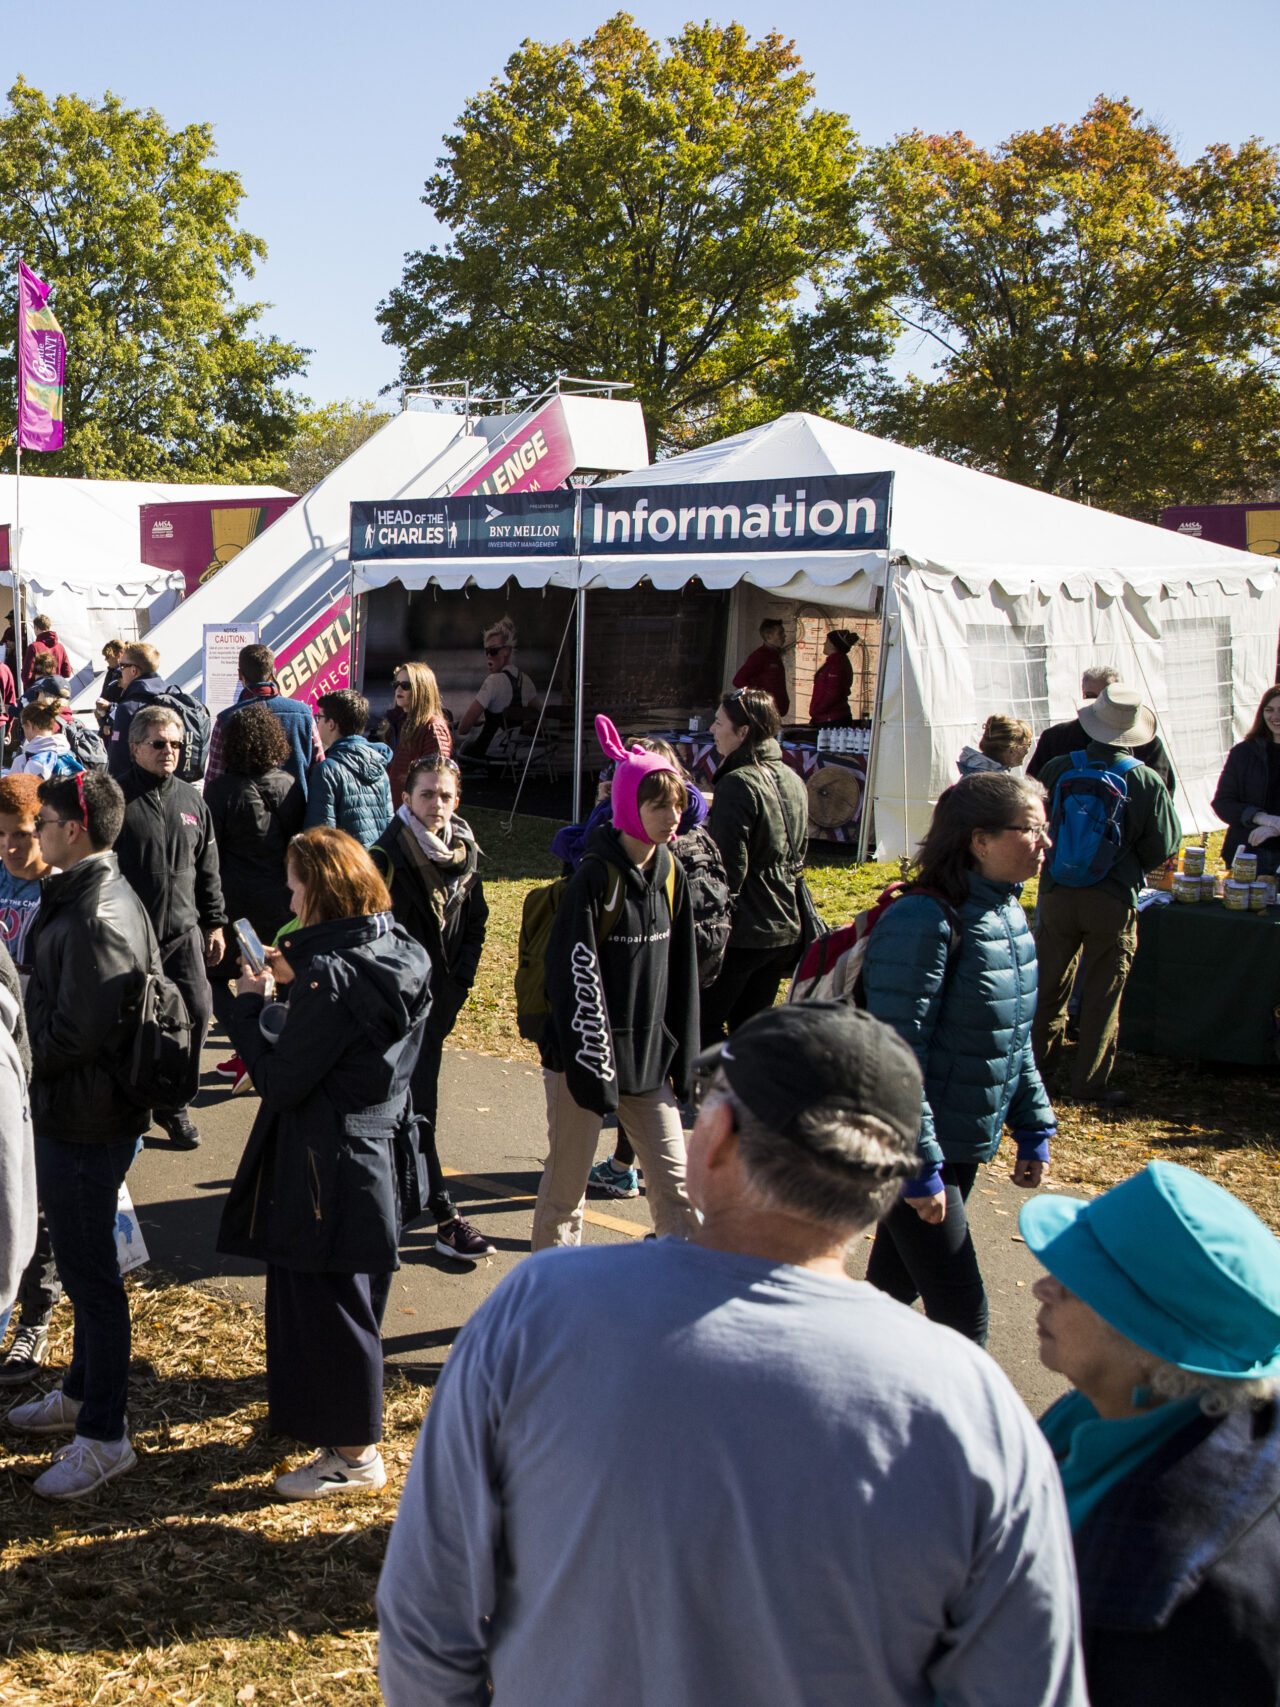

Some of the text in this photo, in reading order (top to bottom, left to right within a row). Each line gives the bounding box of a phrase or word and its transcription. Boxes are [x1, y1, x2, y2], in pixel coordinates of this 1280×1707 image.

[153, 520, 171, 528] AMSA
[377, 510, 444, 525] HEAD OF THE
[592, 489, 877, 544] Information
[378, 527, 445, 545] CHARLES
[489, 525, 560, 537] BNY MELLON
[214, 635, 247, 644] CAUTION:
[183, 731, 194, 772] USA
